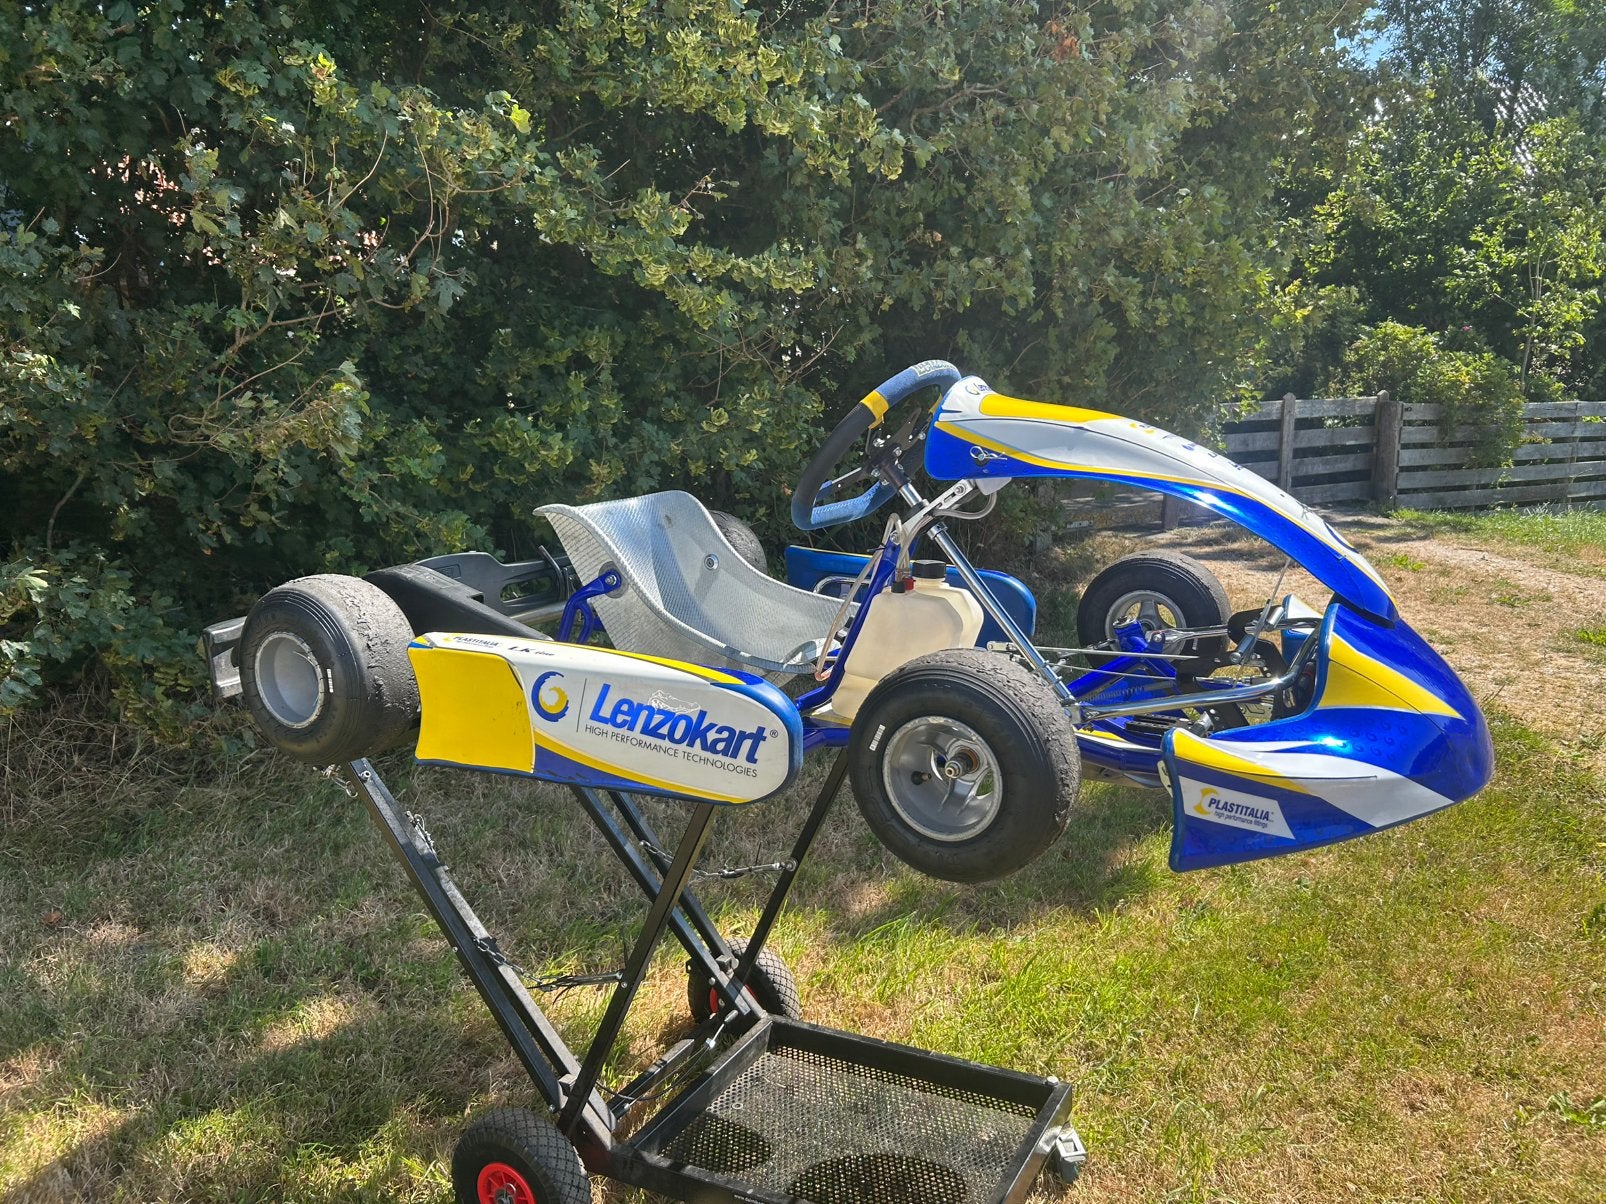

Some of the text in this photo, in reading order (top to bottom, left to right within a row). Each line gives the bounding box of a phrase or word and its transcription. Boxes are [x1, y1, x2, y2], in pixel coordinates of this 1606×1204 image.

[585, 724, 758, 778] HIGH PERFORMANCE TECHNOLOGIES
[1208, 798, 1270, 821] PLASTITALIA
